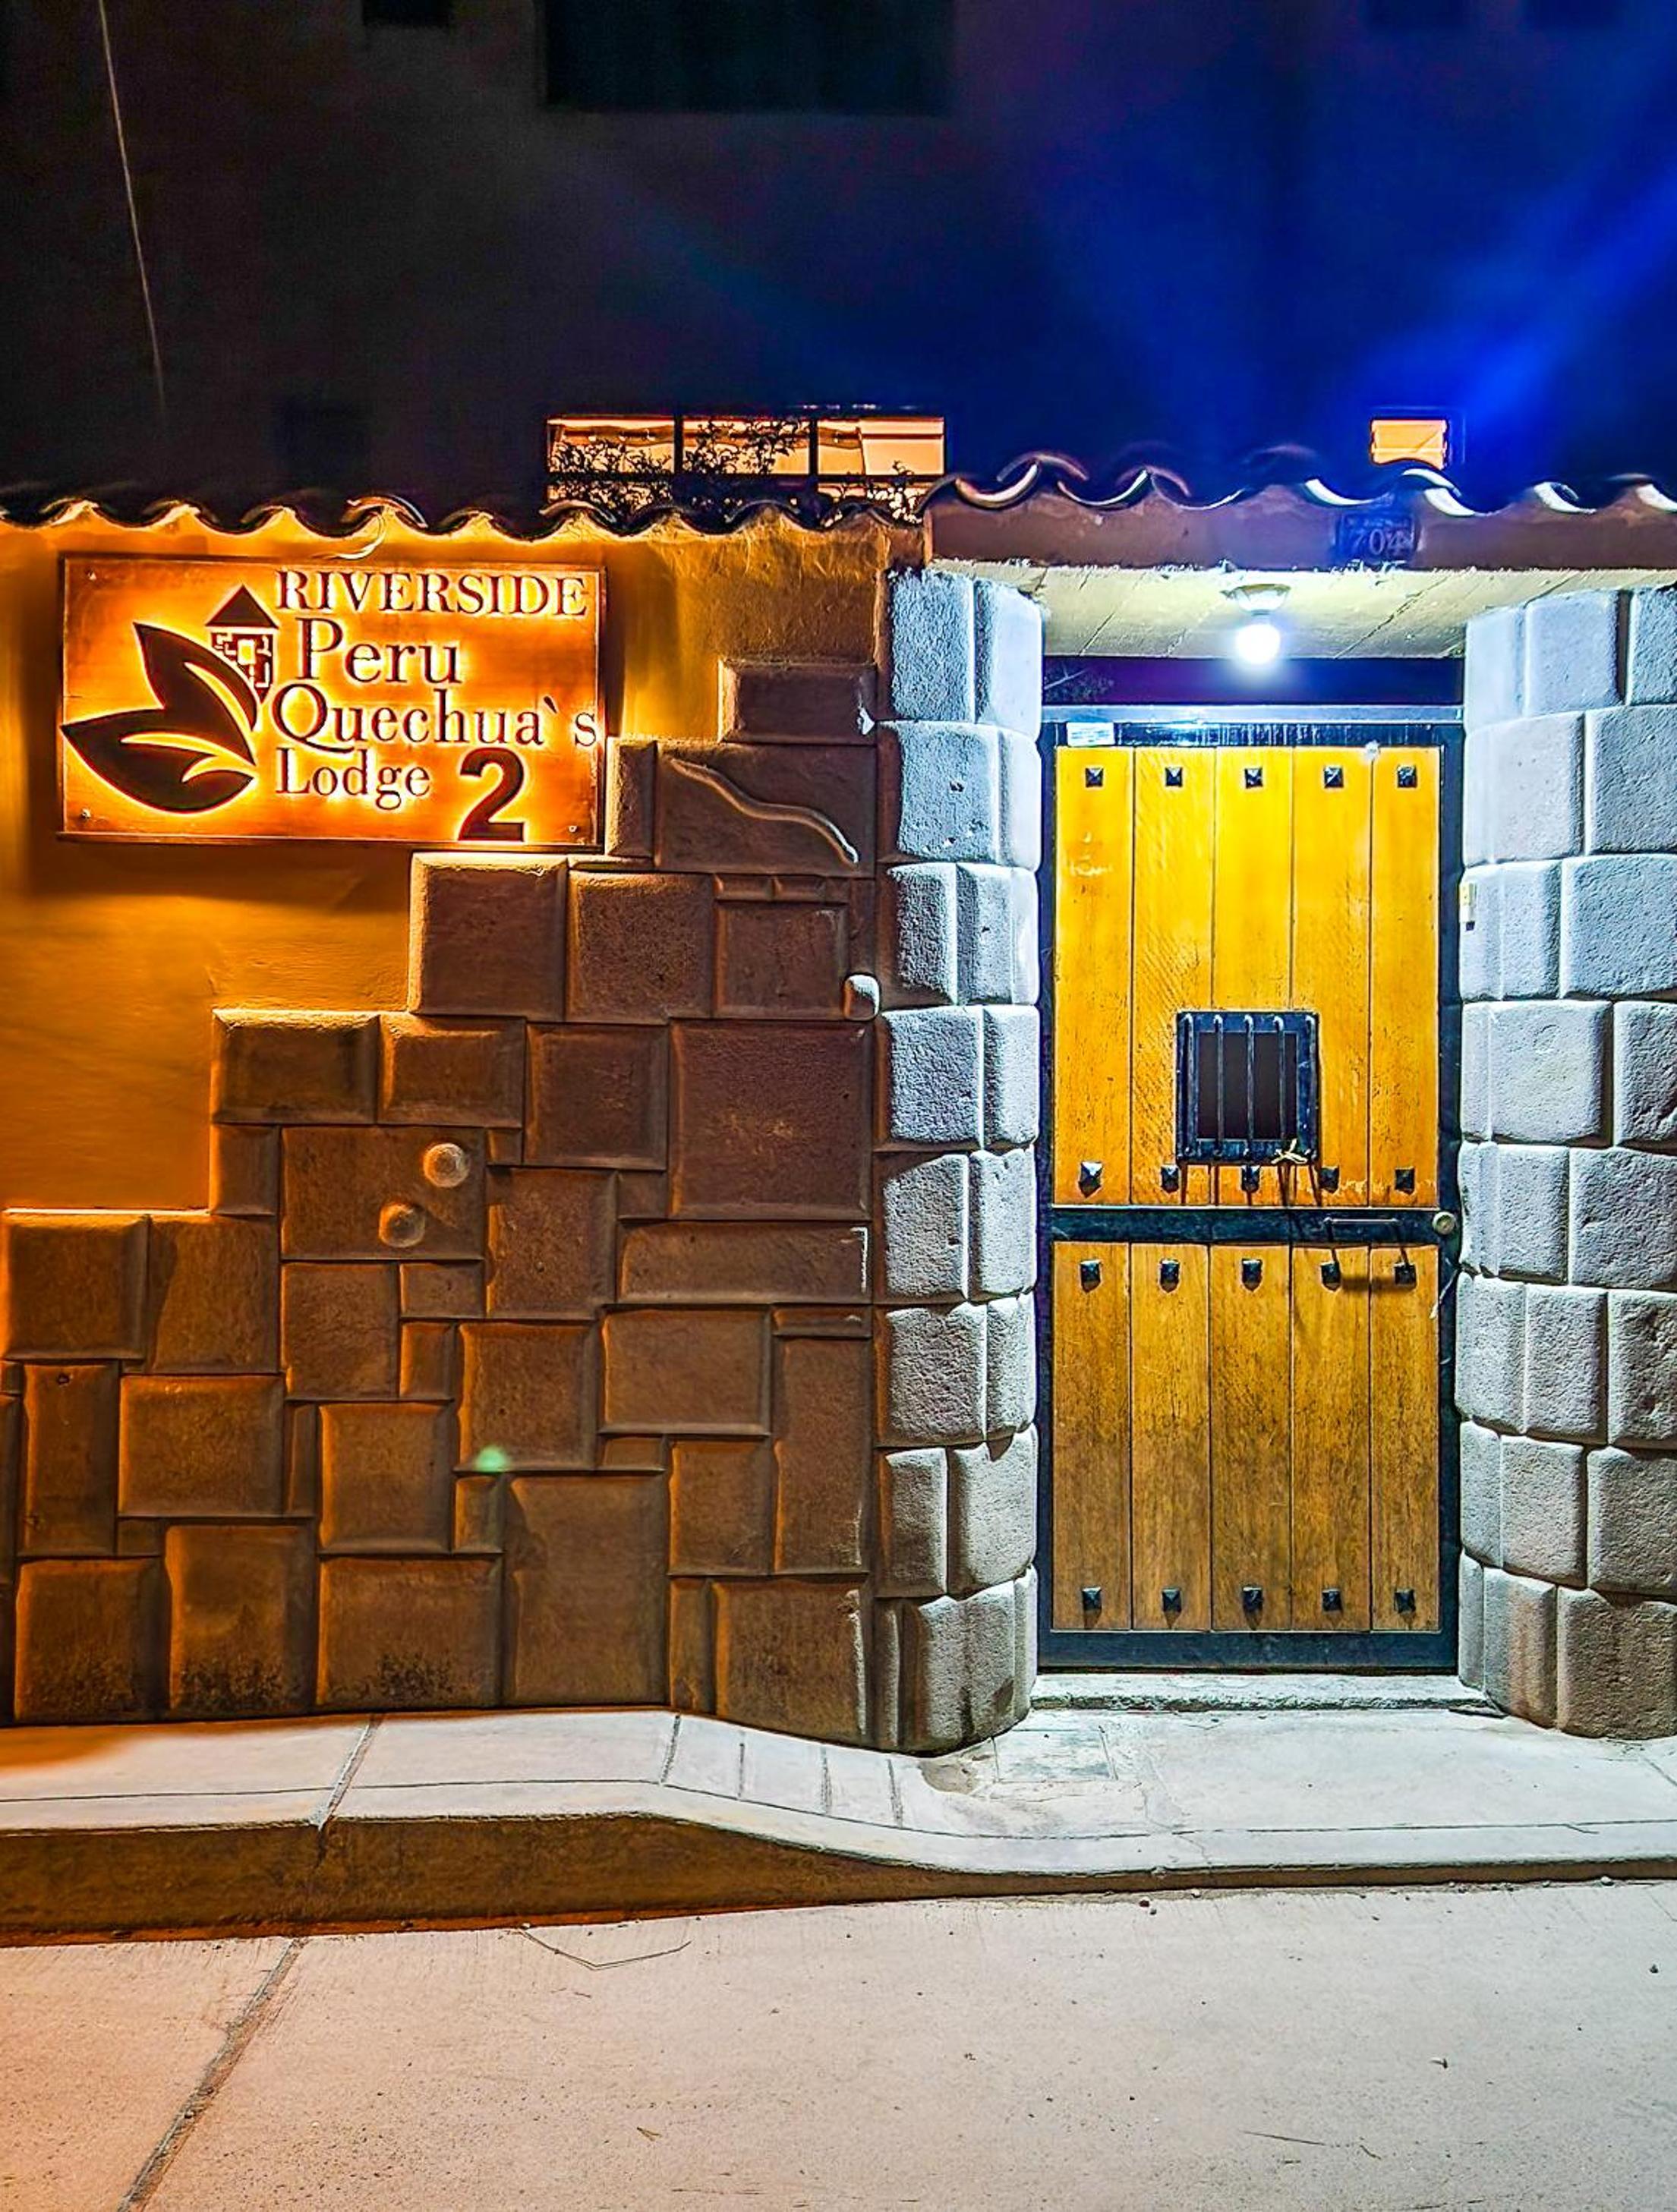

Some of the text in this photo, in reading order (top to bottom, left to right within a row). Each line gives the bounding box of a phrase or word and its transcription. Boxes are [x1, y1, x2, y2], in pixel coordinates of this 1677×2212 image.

[277, 569, 588, 616] RIVERSIDE
[296, 617, 462, 684] Peru
[276, 747, 526, 843] Lodge 2
